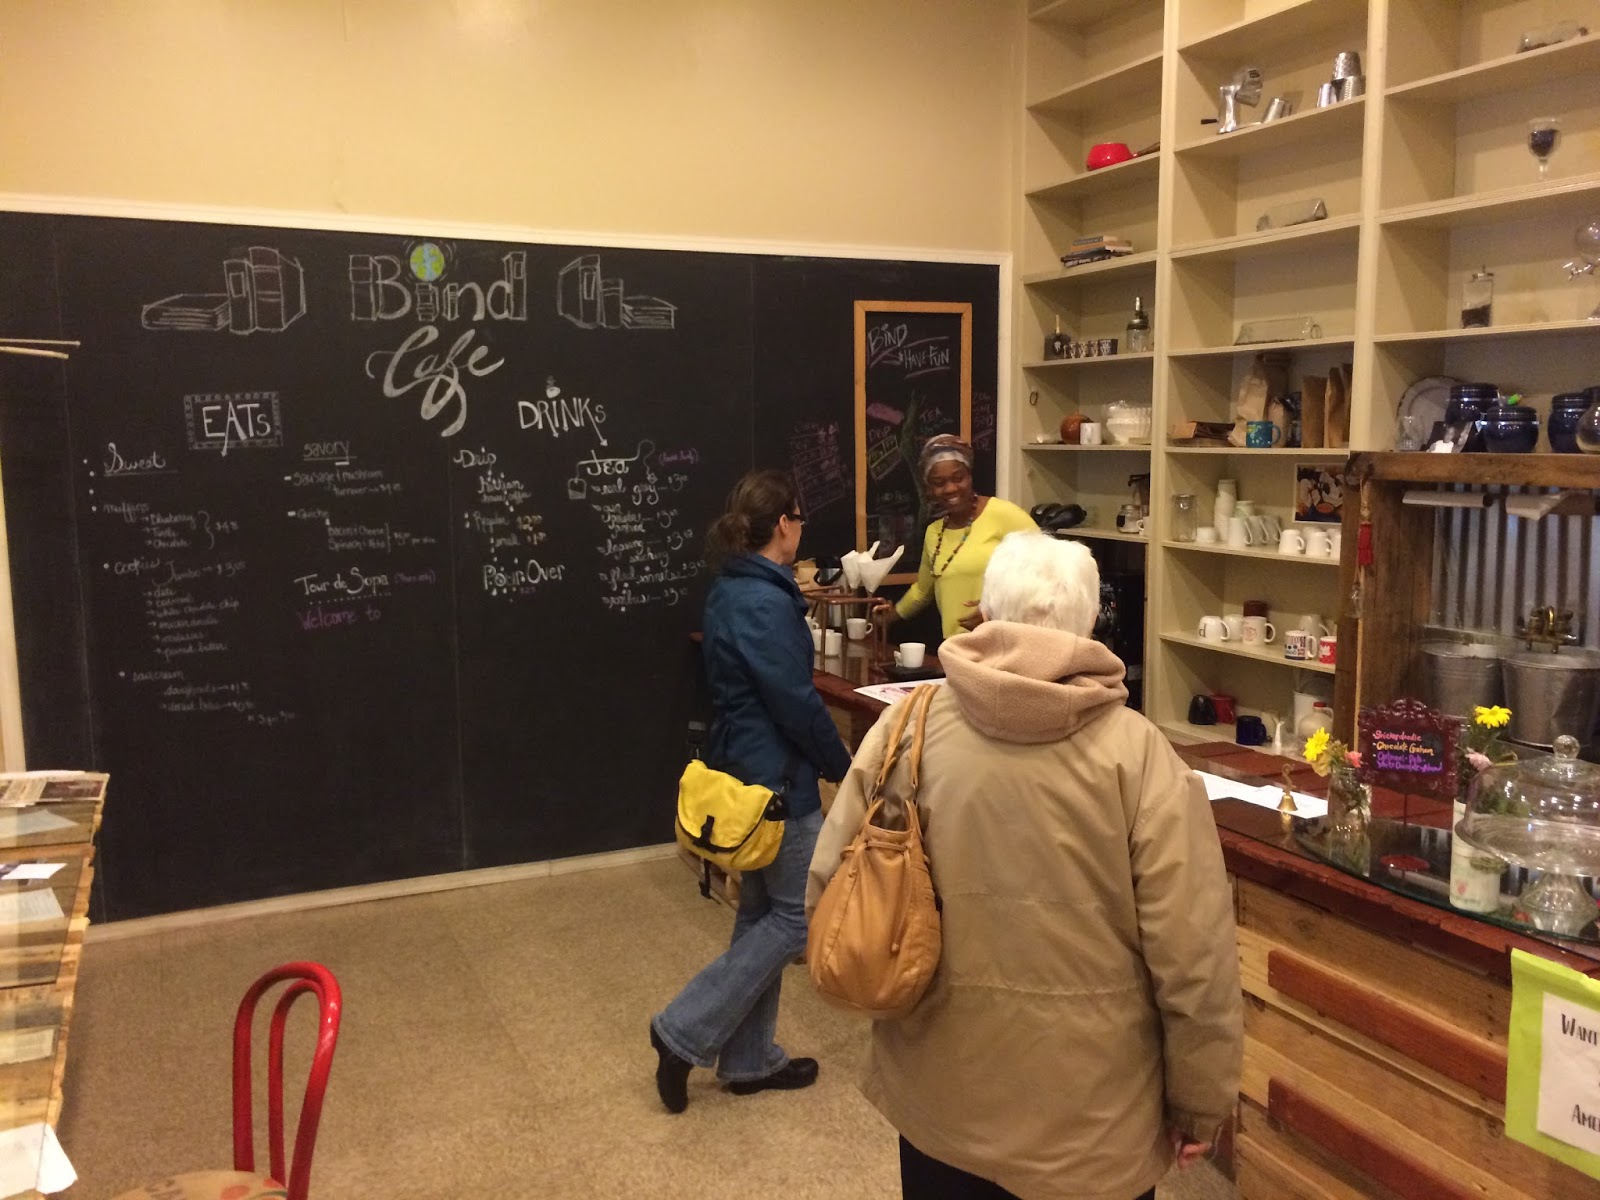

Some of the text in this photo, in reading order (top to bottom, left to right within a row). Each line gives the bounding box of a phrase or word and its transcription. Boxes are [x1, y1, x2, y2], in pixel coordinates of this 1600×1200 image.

[929, 345, 950, 366] FUN
[103, 442, 167, 474] Sweet
[294, 573, 330, 596] Tour
[334, 573, 347, 590] de
[346, 566, 390, 596] Sopa
[527, 559, 565, 584] Over
[297, 604, 381, 630] Welcome to
